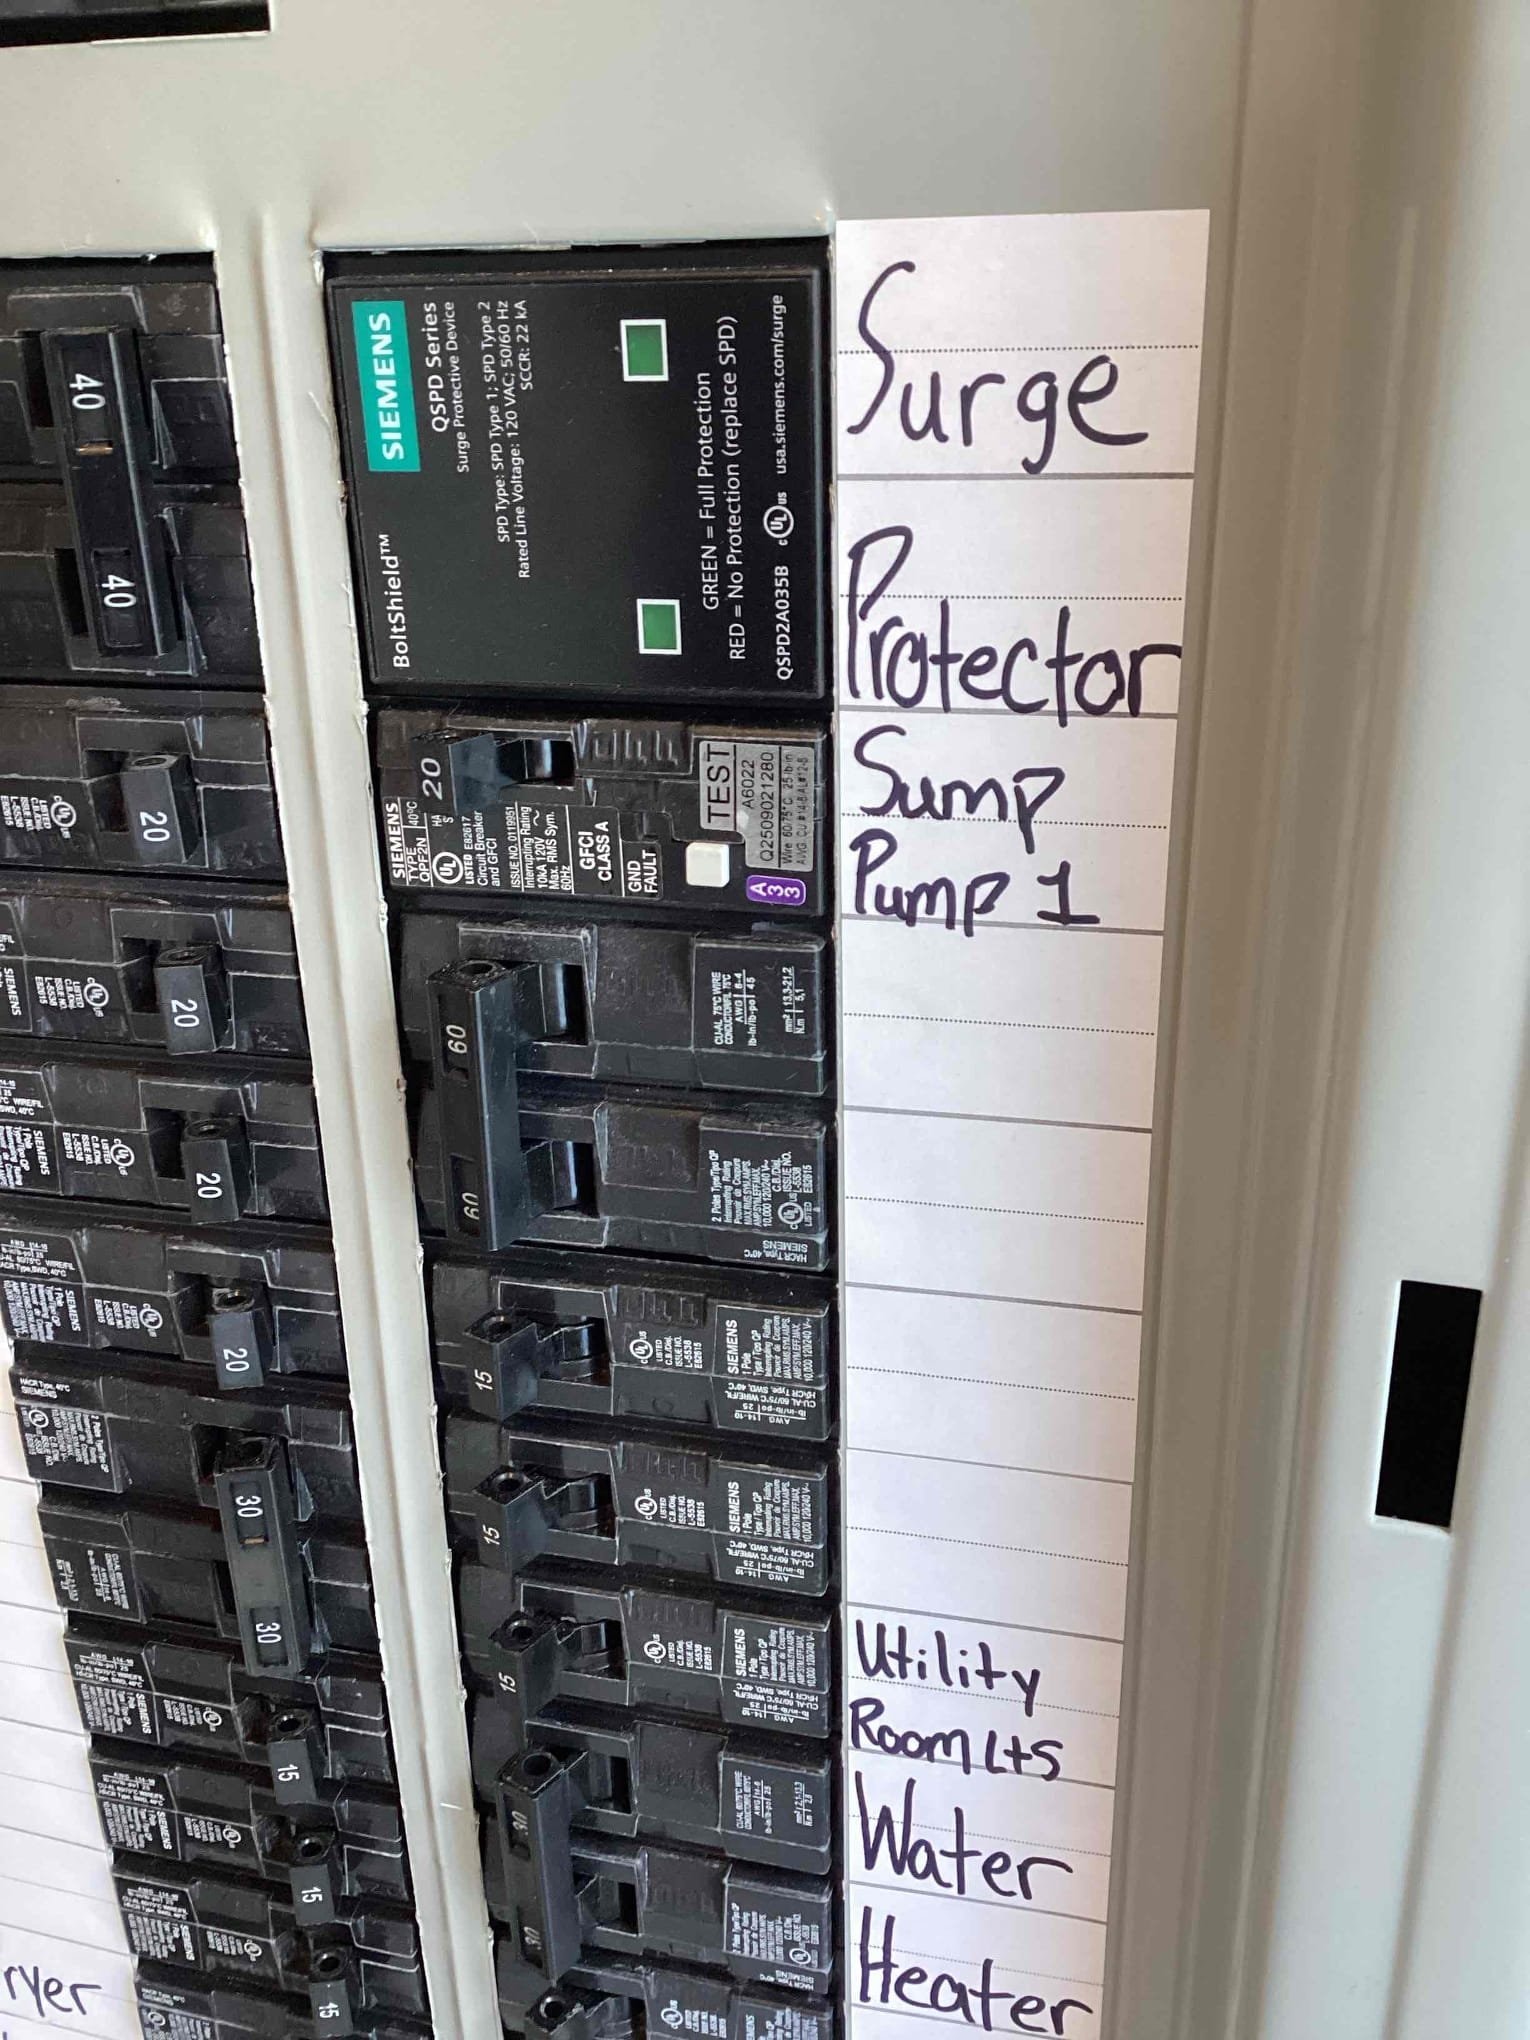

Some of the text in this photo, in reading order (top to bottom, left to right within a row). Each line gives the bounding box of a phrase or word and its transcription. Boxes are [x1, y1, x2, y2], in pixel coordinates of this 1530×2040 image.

[514, 300, 533, 390] SCCR: 22 kA
[368, 313, 404, 460] SIEMENS
[421, 302, 449, 432] QSPD Series
[442, 302, 471, 473] Surge Protective Device
[771, 295, 787, 474] usa.siemens.com/surge
[847, 261, 1148, 474] Surge
[69, 373, 105, 410] 40
[478, 301, 510, 542] SPD Type: SPD Type 1; SPD Type 2
[497, 300, 531, 578] Rated Line Voltage: 120 VAC; 50/60 Hz
[693, 372, 720, 610] GREEN = Full Protection
[716, 316, 746, 659] RED = No Protection (replace SPD)
[101, 574, 136, 608] 40
[775, 566, 794, 680] QSPD2A035B
[848, 525, 1181, 728] Protector
[421, 758, 442, 800] 20
[707, 743, 730, 823] TEST
[742, 760, 755, 809] A6022
[783, 777, 793, 789] 25
[854, 724, 1065, 854] Sump
[140, 811, 170, 842] 20
[760, 753, 773, 861] Q2509021280
[385, 802, 406, 878] SIEMENS
[416, 838, 430, 882] QPF2N
[462, 816, 475, 884] LISTED E82617
[473, 811, 488, 886] Circuit Breaker
[506, 806, 520, 888] ISSUE NO. 0119951
[520, 807, 535, 888] Interrupting Rating
[545, 812, 559, 889] Max. RMS Sym.
[578, 831, 595, 869] GFCI
[596, 821, 612, 881] CLASS A
[783, 843, 793, 864] Wire
[796, 824, 808, 864] AWG CU
[406, 847, 418, 881] TYPE
[486, 838, 500, 886] and GFCI
[534, 837, 548, 888] 10kA 120V
[560, 865, 571, 890] 60Hz
[627, 861, 642, 892] GND
[643, 850, 657, 893] FAULT
[850, 828, 1100, 936] Pump 1
[3, 968, 22, 1017] SIEMENS
[747, 977, 756, 990] 45
[172, 999, 199, 1028] 20
[711, 972, 723, 1045] CU-AL WIRE
[735, 1000, 743, 1022] AWG
[447, 1024, 468, 1055] 60
[33, 1130, 50, 1175] SIEMENS
[781, 1152, 792, 1192] ISSUE NO.
[196, 1172, 222, 1199] 20
[722, 1161, 733, 1223] Interrupting Rating
[734, 1189, 742, 1197] de
[761, 1173, 772, 1227] 10,000 120/240
[793, 1167, 802, 1192] L-5538
[463, 1193, 479, 1220] 60
[711, 1195, 721, 1214] Poles
[804, 1202, 812, 1226] LISTED
[762, 1240, 808, 1253] SIEMENS
[784, 1252, 807, 1263] HACR
[65, 1290, 81, 1332] SIEMENS
[223, 1348, 250, 1373] 20
[726, 1320, 739, 1374] SIEMENS
[741, 1353, 752, 1369] Pole
[21, 1386, 57, 1399] SIEMENS
[475, 1369, 493, 1391] 15
[768, 1416, 790, 1424] AWG
[791, 1398, 816, 1408] CU-AL
[235, 1495, 263, 1518] 30
[728, 1481, 741, 1533] SIEMENS
[484, 1524, 500, 1545] 15
[768, 1574, 789, 1582] AWG
[255, 1622, 282, 1644] 30
[734, 1628, 747, 1676] SIEMENS
[499, 1673, 516, 1693] 15
[856, 1620, 1040, 1717] Utility
[136, 1693, 152, 1735] SIEMENS
[850, 1697, 970, 1774] Room
[277, 1764, 299, 1782] 15
[156, 1810, 172, 1850] SIEMENS
[511, 1811, 529, 1836] 30
[855, 1771, 1073, 1900] Water
[301, 1886, 323, 1904] 15
[180, 1924, 195, 1961] SIEMENS
[523, 1926, 542, 1951] 30
[860, 1906, 1093, 2035] Heater
[318, 2002, 340, 2018] 15
